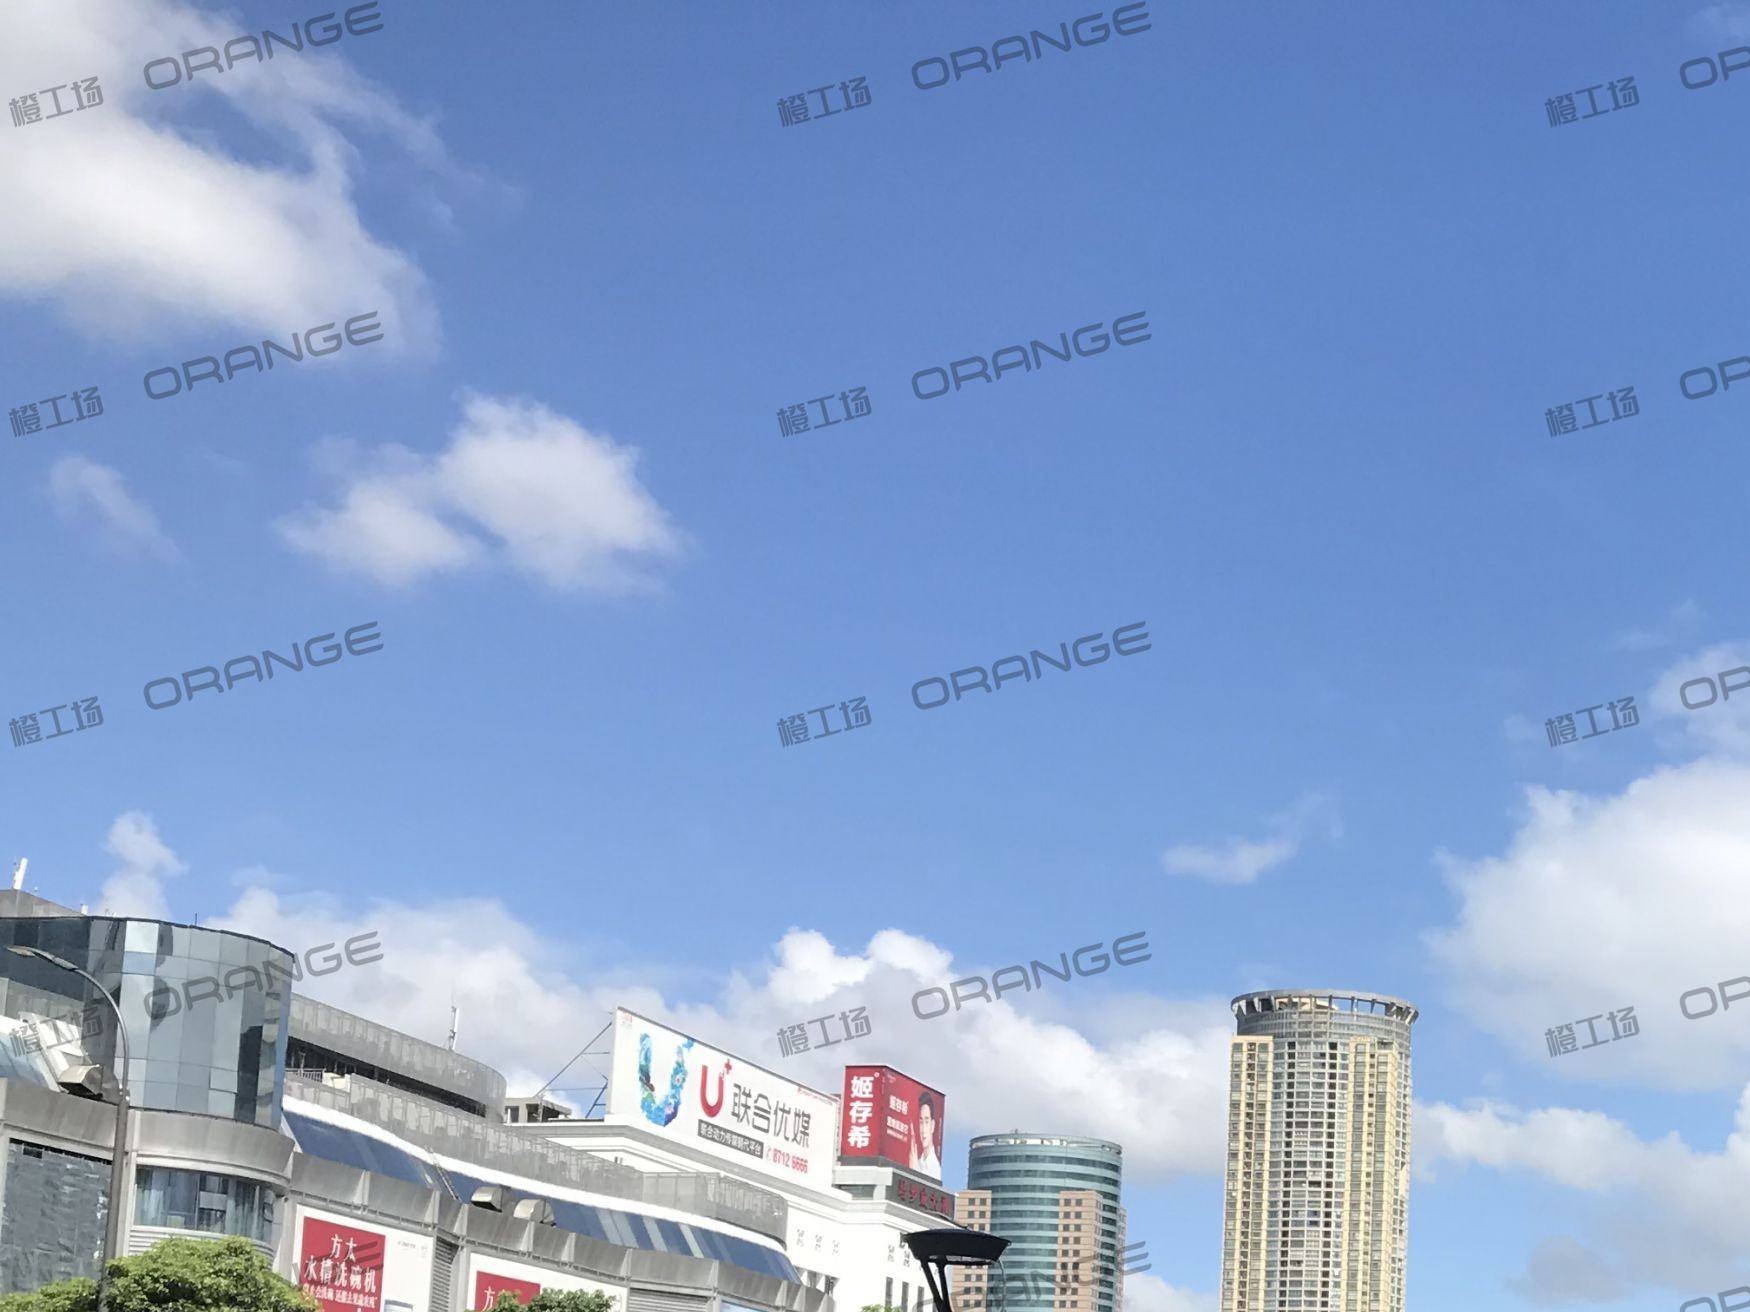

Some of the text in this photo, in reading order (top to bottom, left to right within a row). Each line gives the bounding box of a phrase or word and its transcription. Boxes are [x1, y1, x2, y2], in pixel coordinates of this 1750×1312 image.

[732, 1083, 811, 1148] 联合优媒
[848, 1076, 875, 1149] 姬存希
[772, 1148, 790, 1167] 8712
[330, 1234, 357, 1263] 方太
[304, 1256, 377, 1293] 水槽洗碗机
